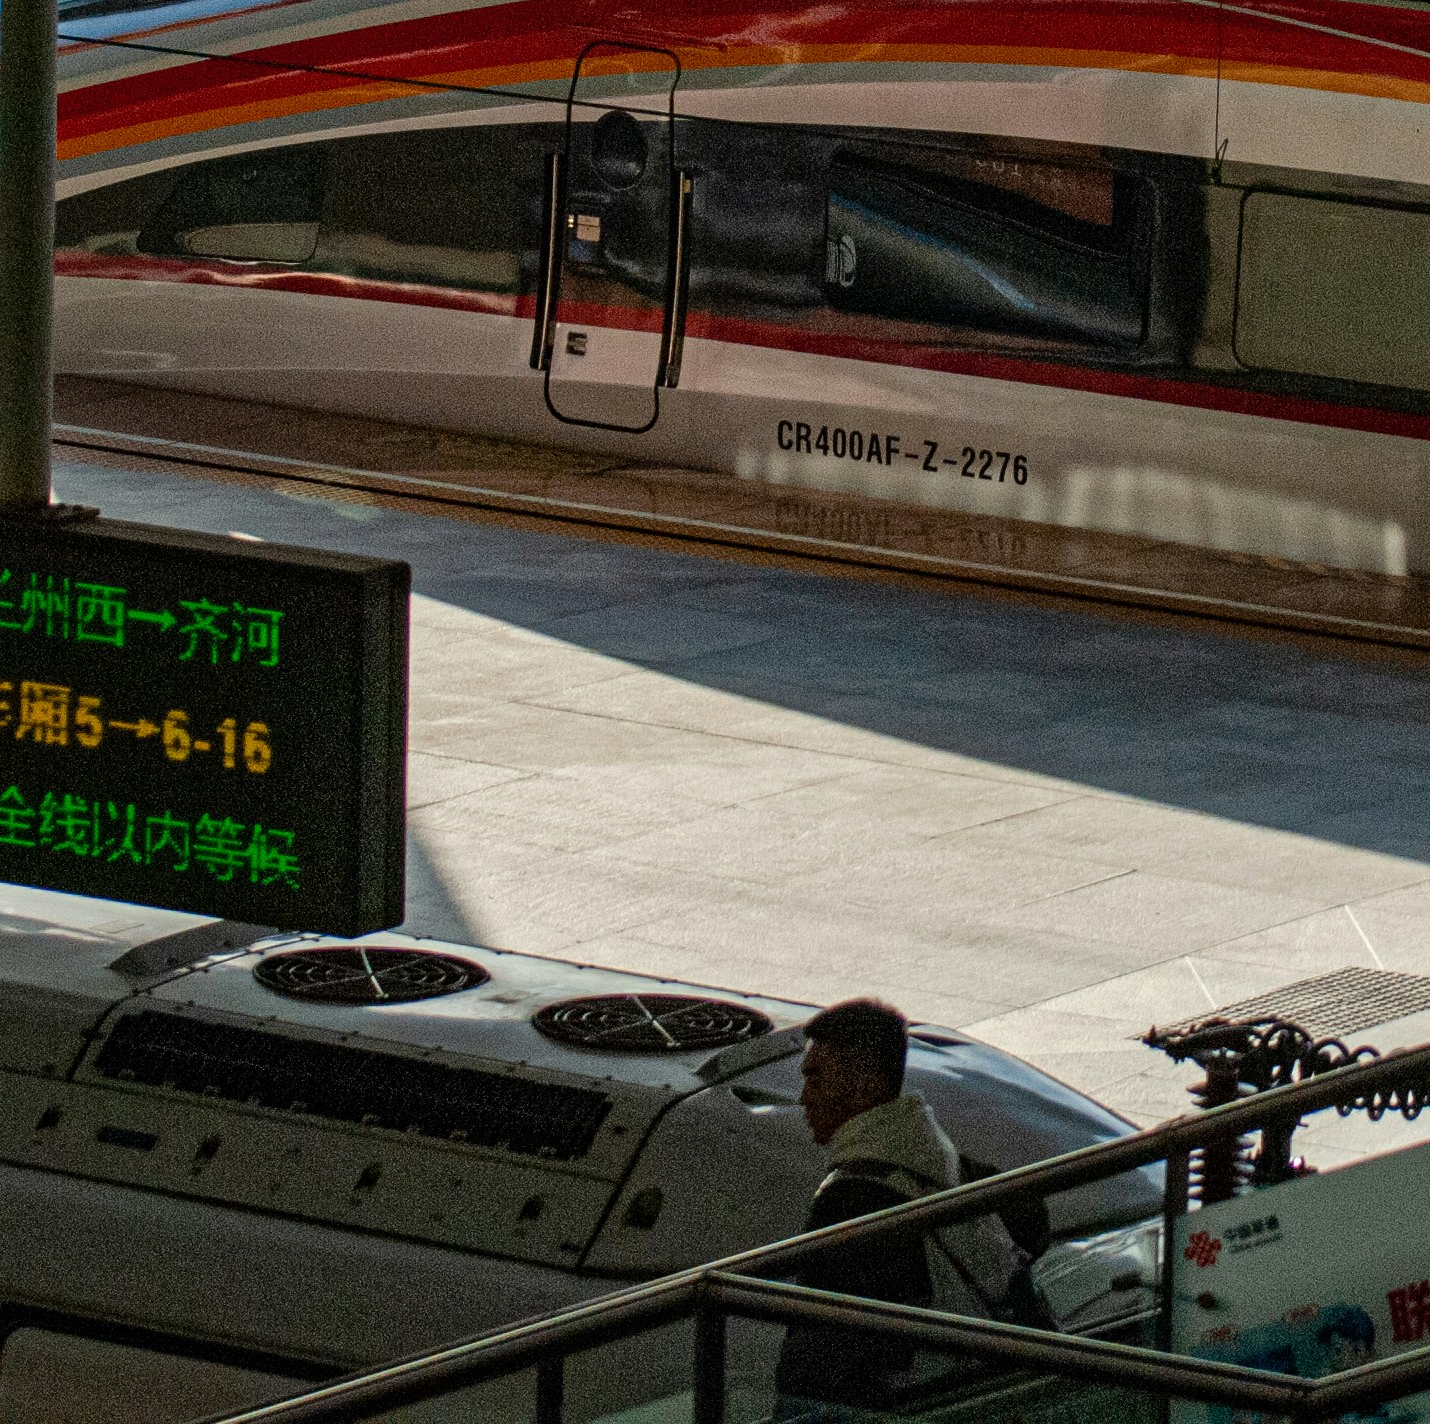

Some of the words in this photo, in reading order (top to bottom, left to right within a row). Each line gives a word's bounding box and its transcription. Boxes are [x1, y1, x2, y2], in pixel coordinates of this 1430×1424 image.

[777, 419, 1028, 486] CR400AF-Z-2276
[179, 597, 285, 667] 齐河
[163, 709, 272, 774] 6-16
